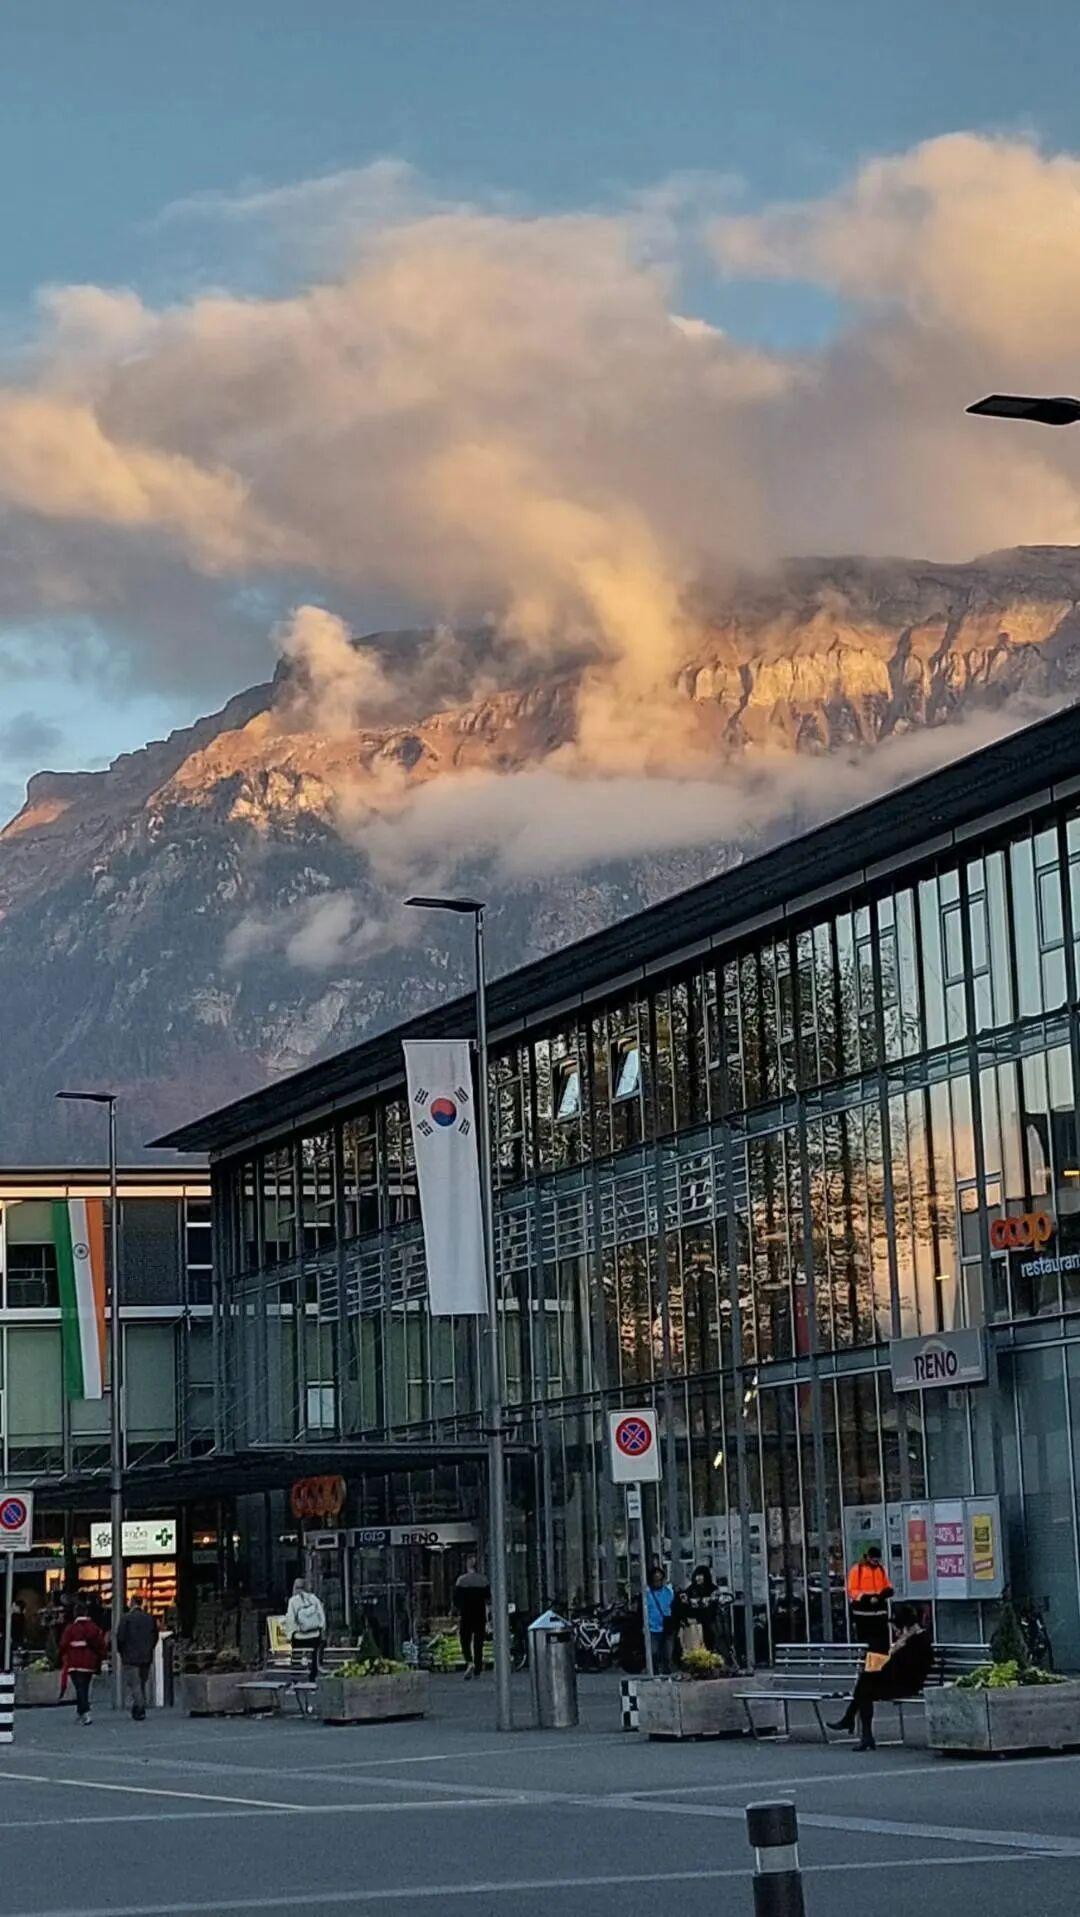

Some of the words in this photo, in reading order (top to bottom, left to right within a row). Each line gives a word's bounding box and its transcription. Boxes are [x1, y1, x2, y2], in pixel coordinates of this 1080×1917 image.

[991, 1211, 1051, 1252] coop
[913, 1350, 958, 1381] RENO
[401, 1532, 439, 1544] RENO
